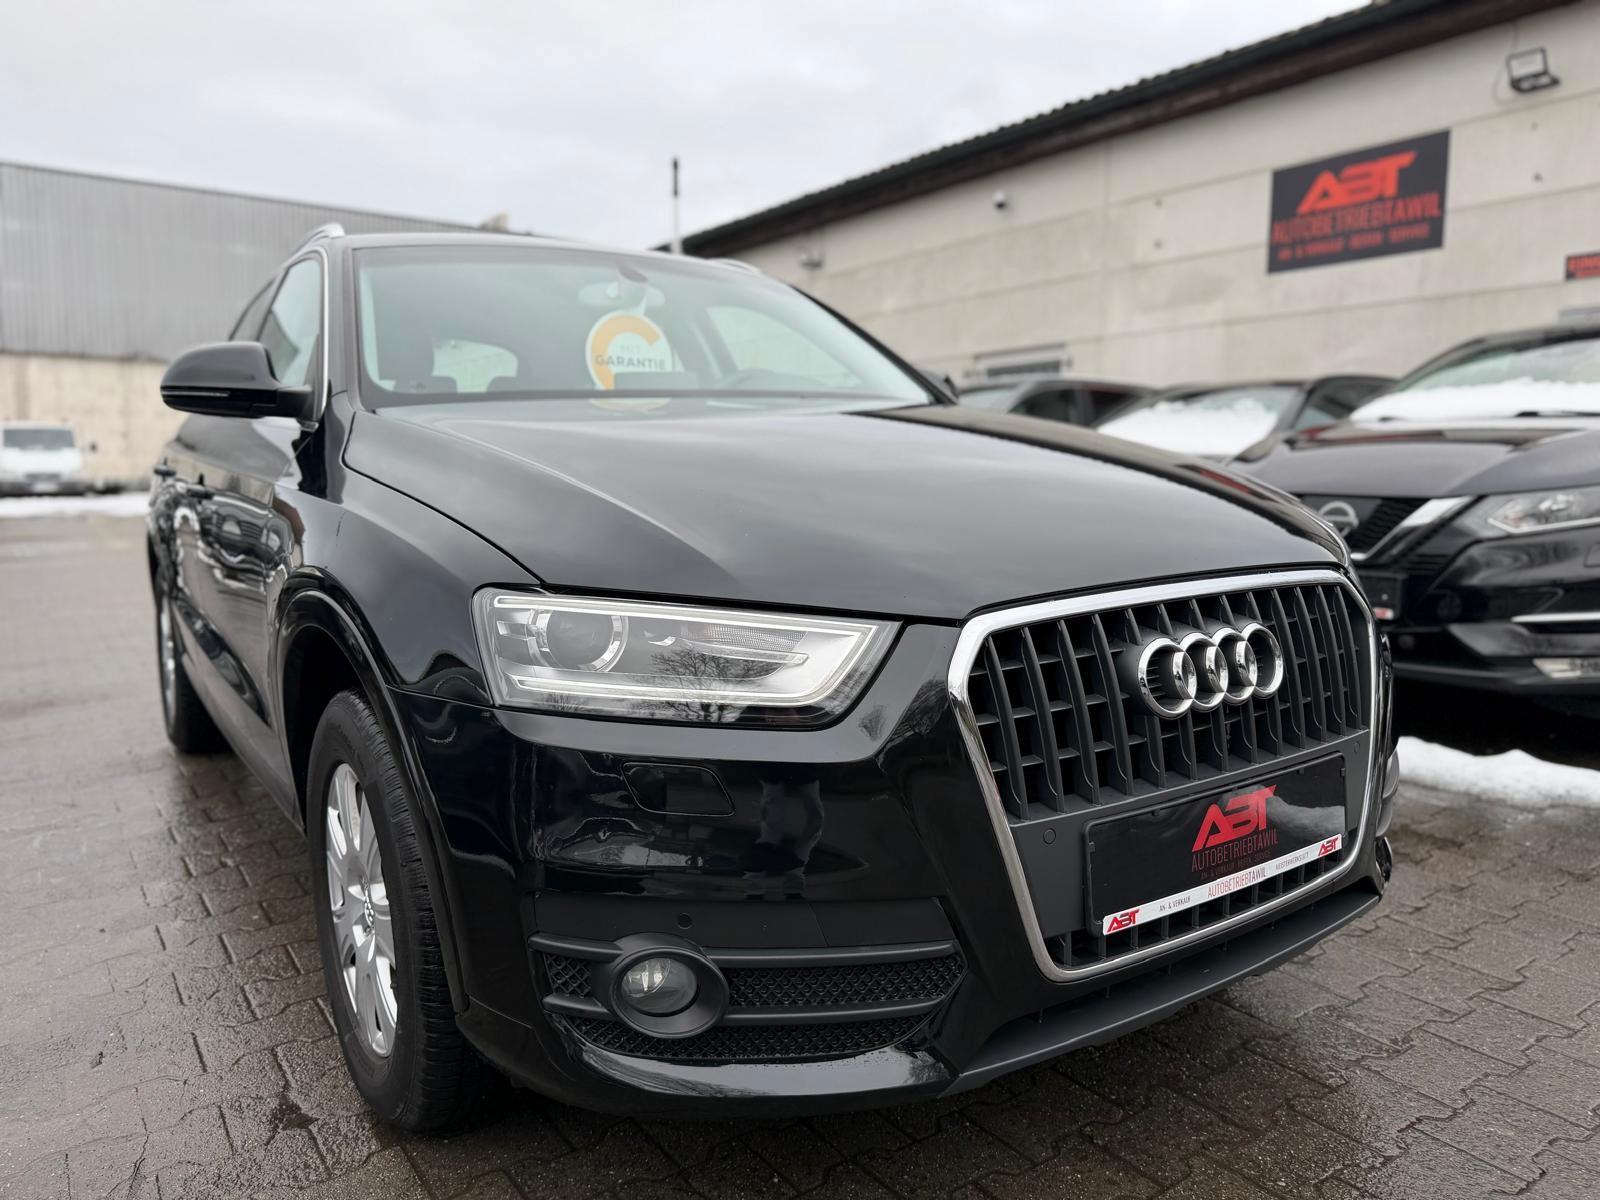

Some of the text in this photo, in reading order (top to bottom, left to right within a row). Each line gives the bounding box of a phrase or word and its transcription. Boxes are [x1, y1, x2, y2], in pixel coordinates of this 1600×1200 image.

[1296, 149, 1417, 214] ABT
[594, 354, 667, 370] GARANTIE
[1191, 829, 1279, 872] AUTOBETRIEBTAWIL
[1192, 784, 1277, 852] ABT
[1106, 908, 1140, 933] ABT
[1207, 866, 1267, 899] AUTOBETRIEBTAWIL
[1317, 836, 1339, 858] ABT
